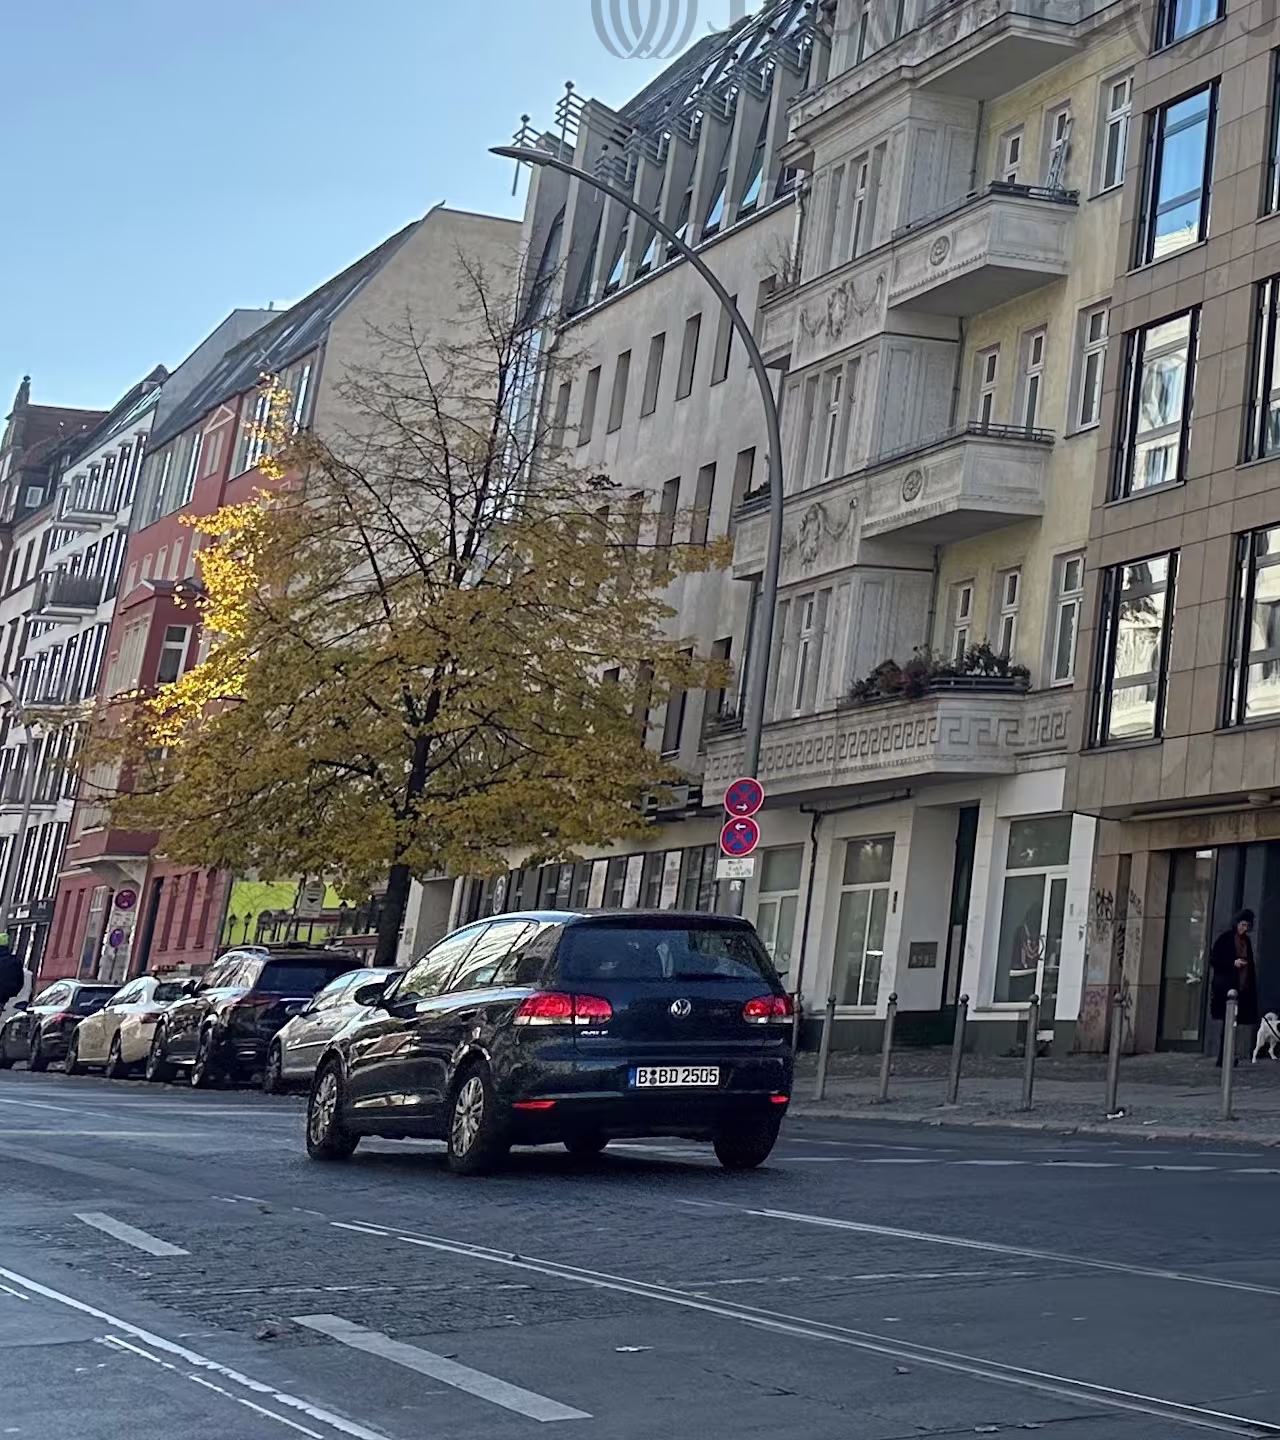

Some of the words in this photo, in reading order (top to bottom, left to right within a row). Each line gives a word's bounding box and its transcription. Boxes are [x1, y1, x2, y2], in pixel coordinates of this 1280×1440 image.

[638, 1069, 648, 1084] B
[658, 1068, 679, 1084] BD
[681, 1068, 718, 1083] 2505
